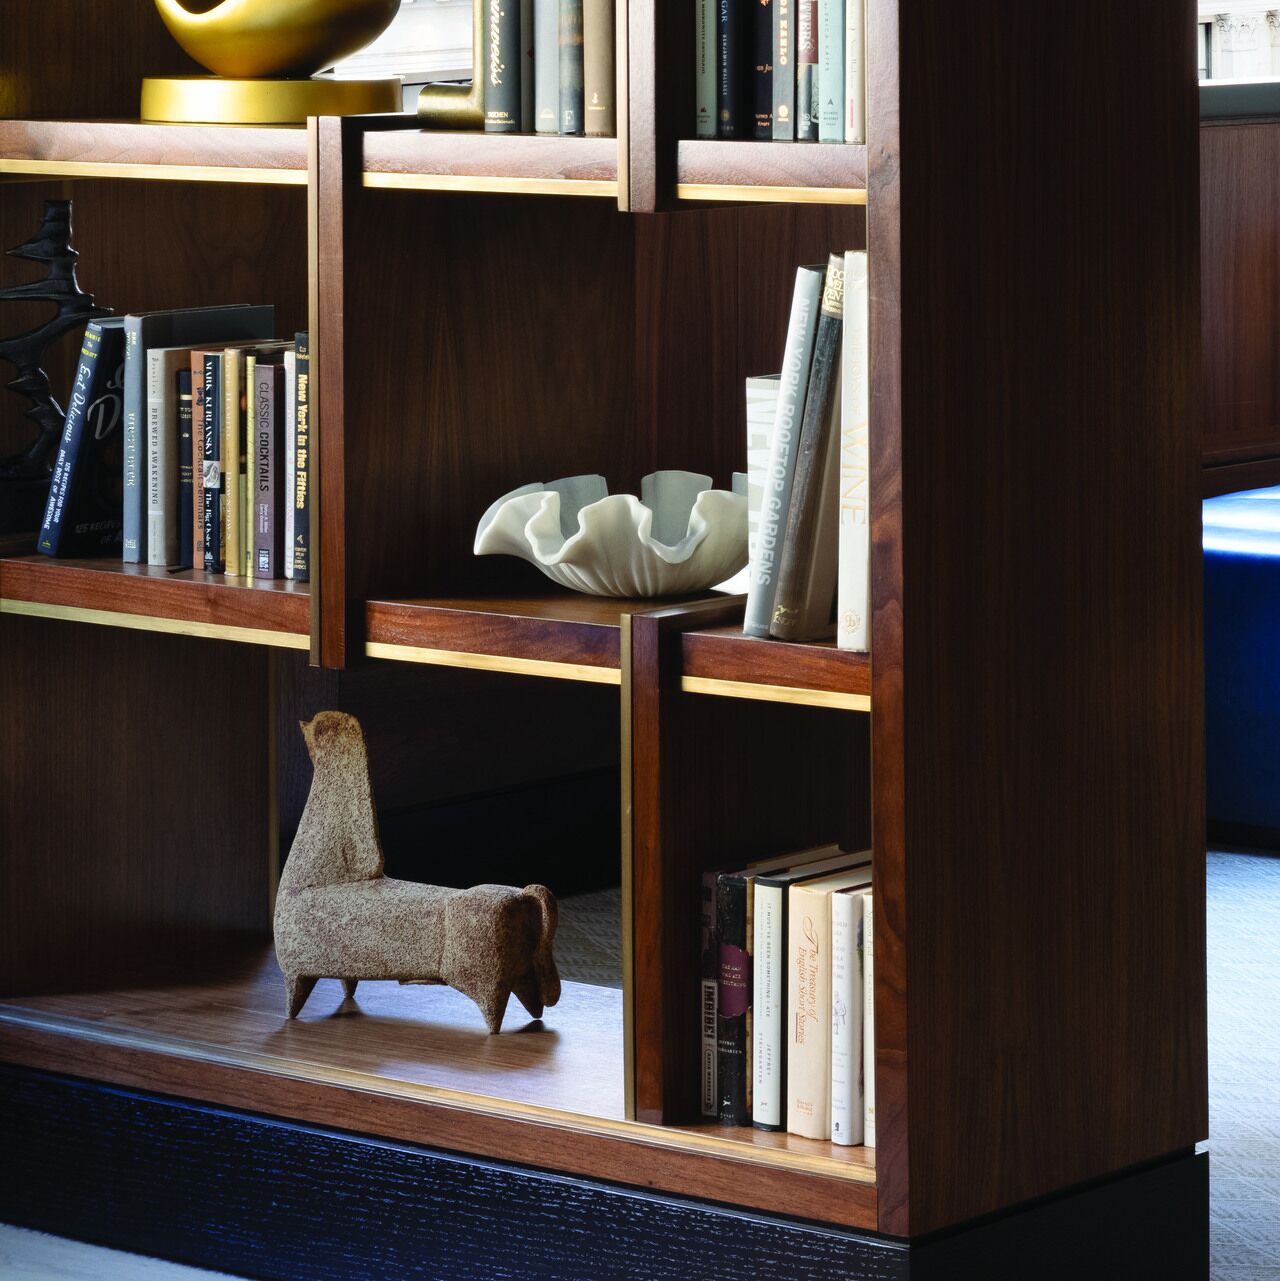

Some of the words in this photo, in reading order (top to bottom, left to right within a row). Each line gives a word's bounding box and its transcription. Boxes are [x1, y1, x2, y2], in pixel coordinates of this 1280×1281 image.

[779, 20, 788, 65] KAHLO
[791, 297, 810, 347] NEW
[76, 363, 91, 390] Eat
[297, 374, 308, 402] New
[784, 348, 804, 400] YORK
[64, 393, 87, 443] Delicious
[205, 396, 213, 455] KURLANSKY
[259, 382, 269, 427] CLASSIC
[297, 404, 308, 432] York
[259, 432, 269, 491] COCKTAILS
[297, 449, 307, 469] the
[772, 405, 796, 491] ROOFTOP
[59, 472, 70, 496] RECIPES
[296, 472, 307, 509] Fifties
[842, 424, 867, 525] WINE
[53, 509, 62, 522] YOUR
[204, 509, 212, 522] Big
[757, 495, 782, 586] GARDENS
